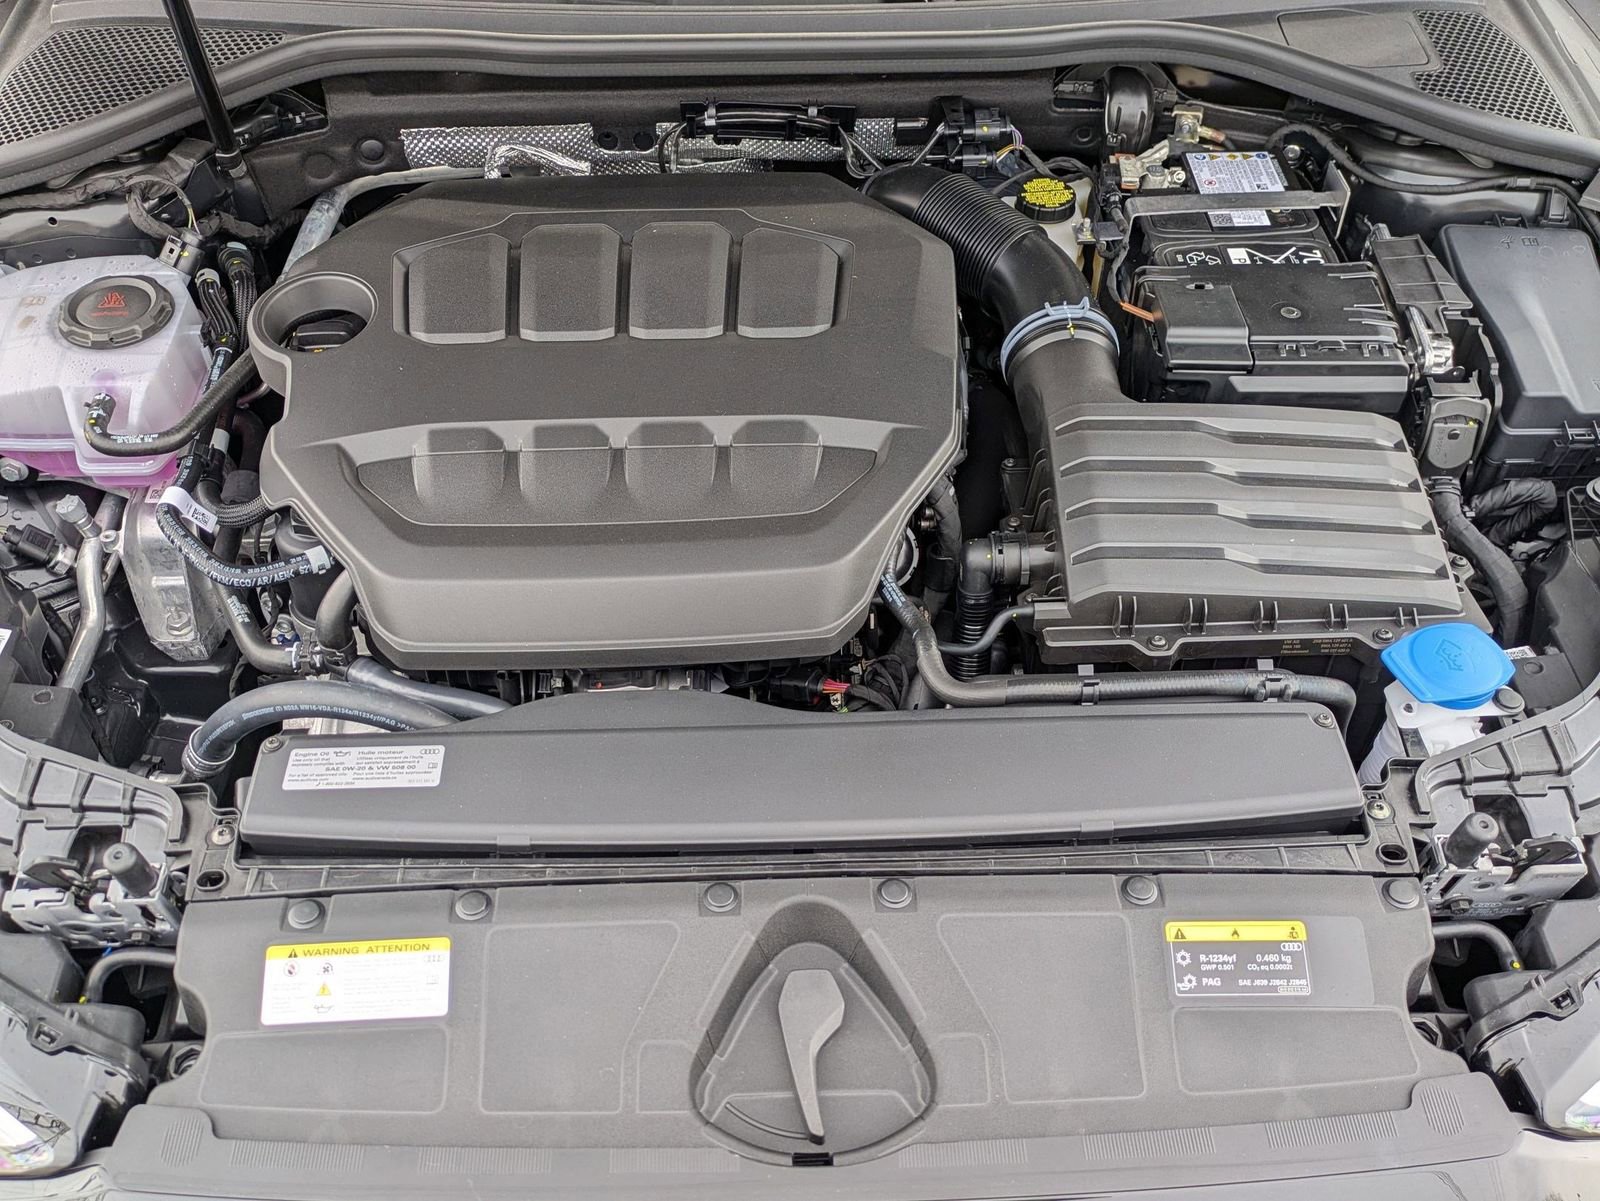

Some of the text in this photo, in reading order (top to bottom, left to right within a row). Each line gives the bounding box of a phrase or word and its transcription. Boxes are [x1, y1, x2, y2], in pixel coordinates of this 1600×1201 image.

[303, 943, 430, 957] WARNING ATTENTION
[1200, 953, 1237, 964] R-1234yf
[1280, 953, 1292, 964] kg
[1202, 977, 1222, 986] PAG
